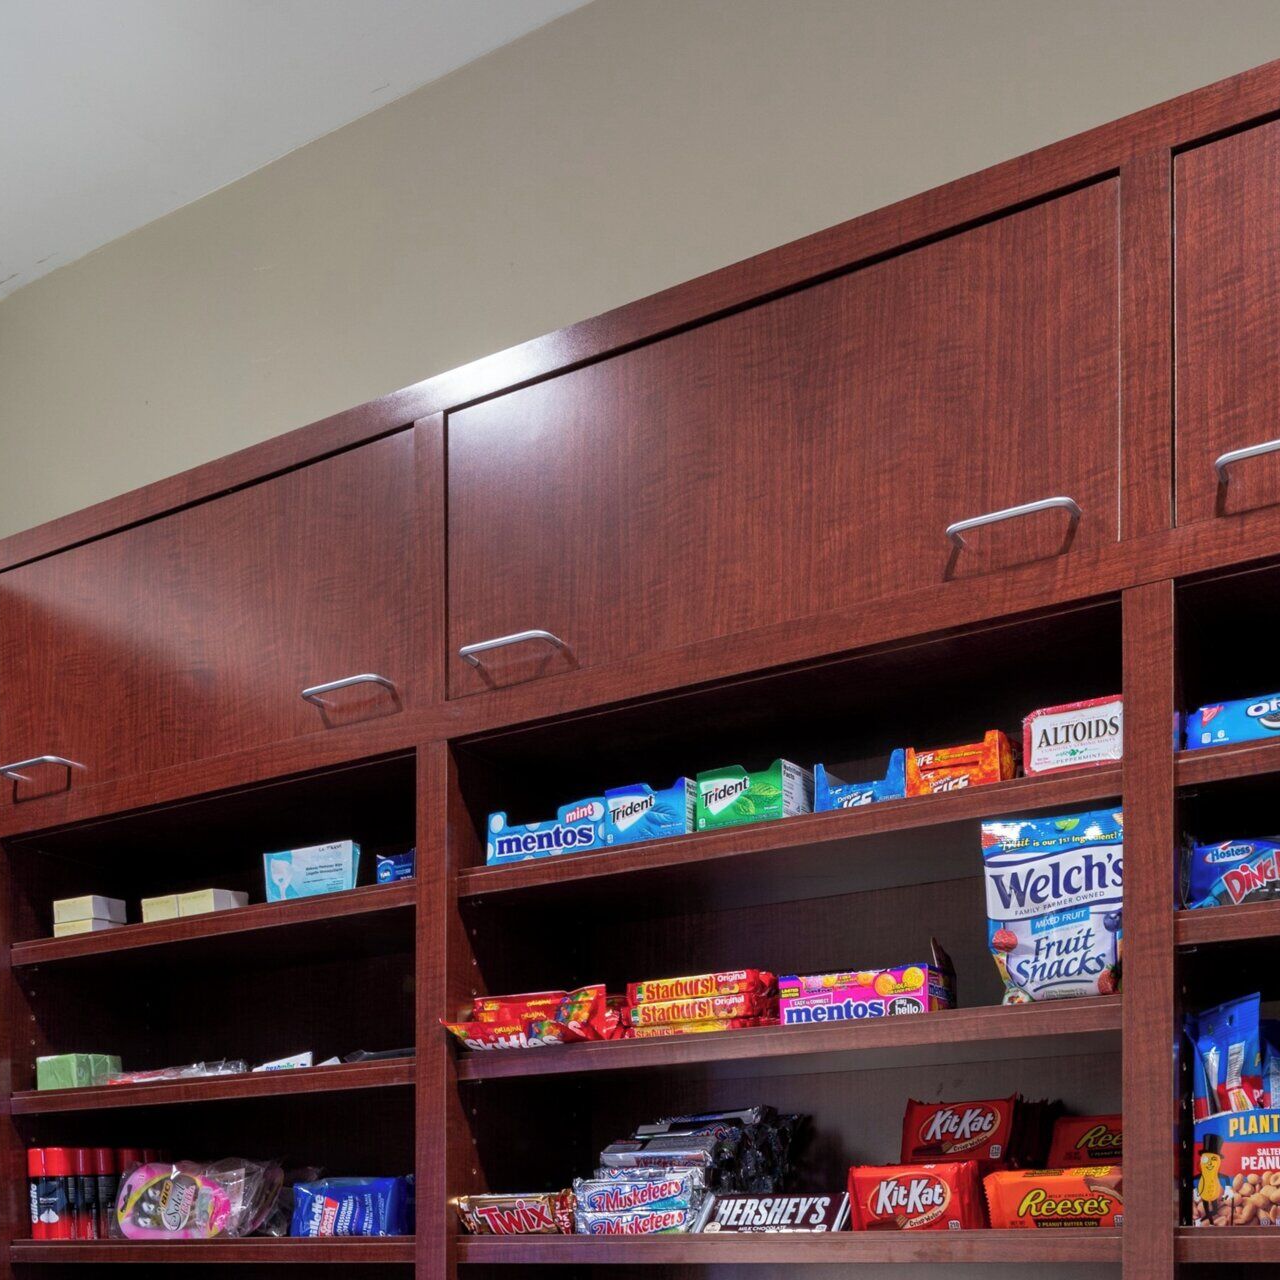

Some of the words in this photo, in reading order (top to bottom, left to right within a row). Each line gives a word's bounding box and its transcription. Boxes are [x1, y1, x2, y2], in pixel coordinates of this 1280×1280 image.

[1037, 716, 1119, 748] ALTOIDS
[701, 777, 749, 807] Trident
[566, 803, 594, 823] mint
[609, 795, 653, 824] Trident
[497, 825, 594, 855] mentos
[1209, 845, 1251, 861] Hostess
[990, 853, 1123, 909] Welch's
[1223, 855, 1277, 904] DING
[1015, 905, 1040, 916] FAMILY
[1076, 891, 1105, 902] OWNED
[1035, 916, 1059, 929] MIXED
[1062, 910, 1086, 922] FRUIT
[1033, 929, 1095, 964] Fruit
[1016, 951, 1107, 988] Snacks
[646, 976, 716, 1002] Starburst
[717, 971, 746, 982] Original
[641, 1000, 713, 1024] Starburst
[714, 996, 744, 1006] Original
[785, 998, 884, 1024] mentos
[895, 1004, 918, 1015] hello
[30, 1183, 38, 1223] Gillette
[161, 1183, 171, 1206] BIC
[604, 1179, 686, 1211] Musketeers
[1018, 1189, 1112, 1218] Reese's
[478, 1200, 555, 1234] Twix
[718, 1196, 831, 1226] HERSHEY'S
